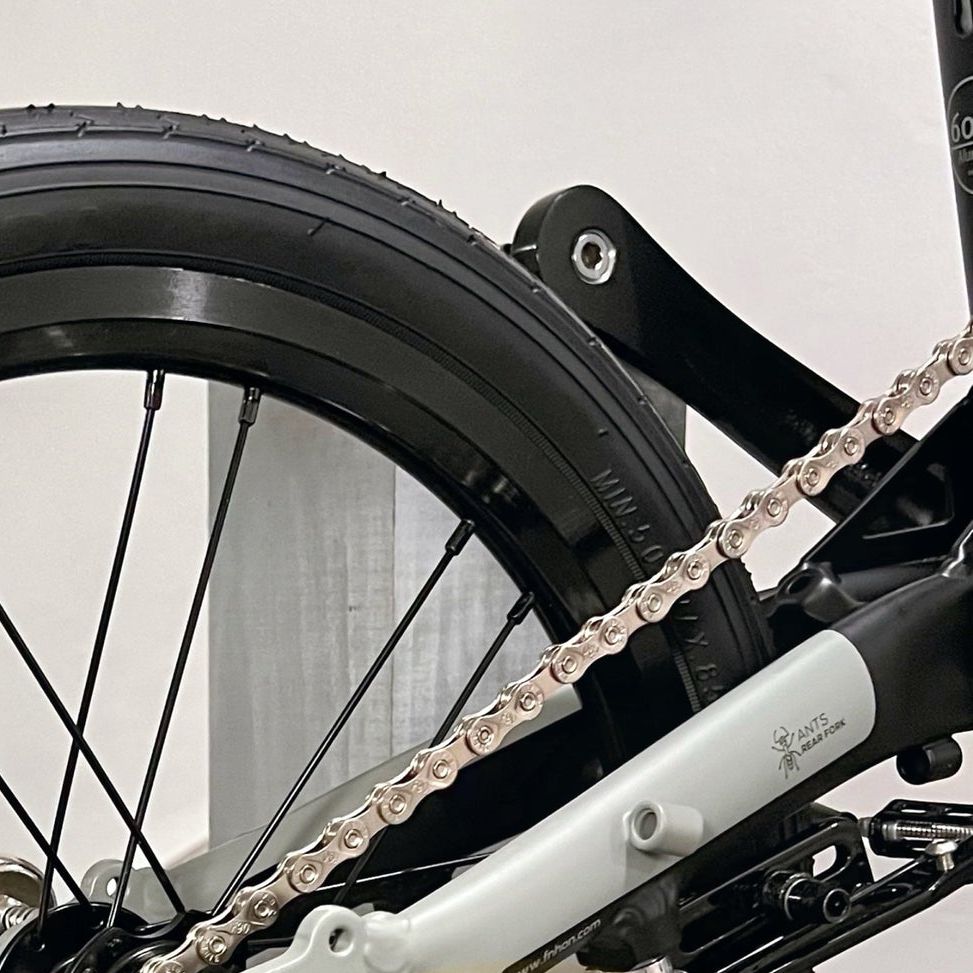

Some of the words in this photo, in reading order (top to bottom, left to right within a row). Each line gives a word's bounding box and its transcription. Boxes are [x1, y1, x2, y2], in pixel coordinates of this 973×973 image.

[797, 712, 829, 742] ANTS
[801, 733, 823, 754] REAR
[823, 718, 846, 738] FORK
